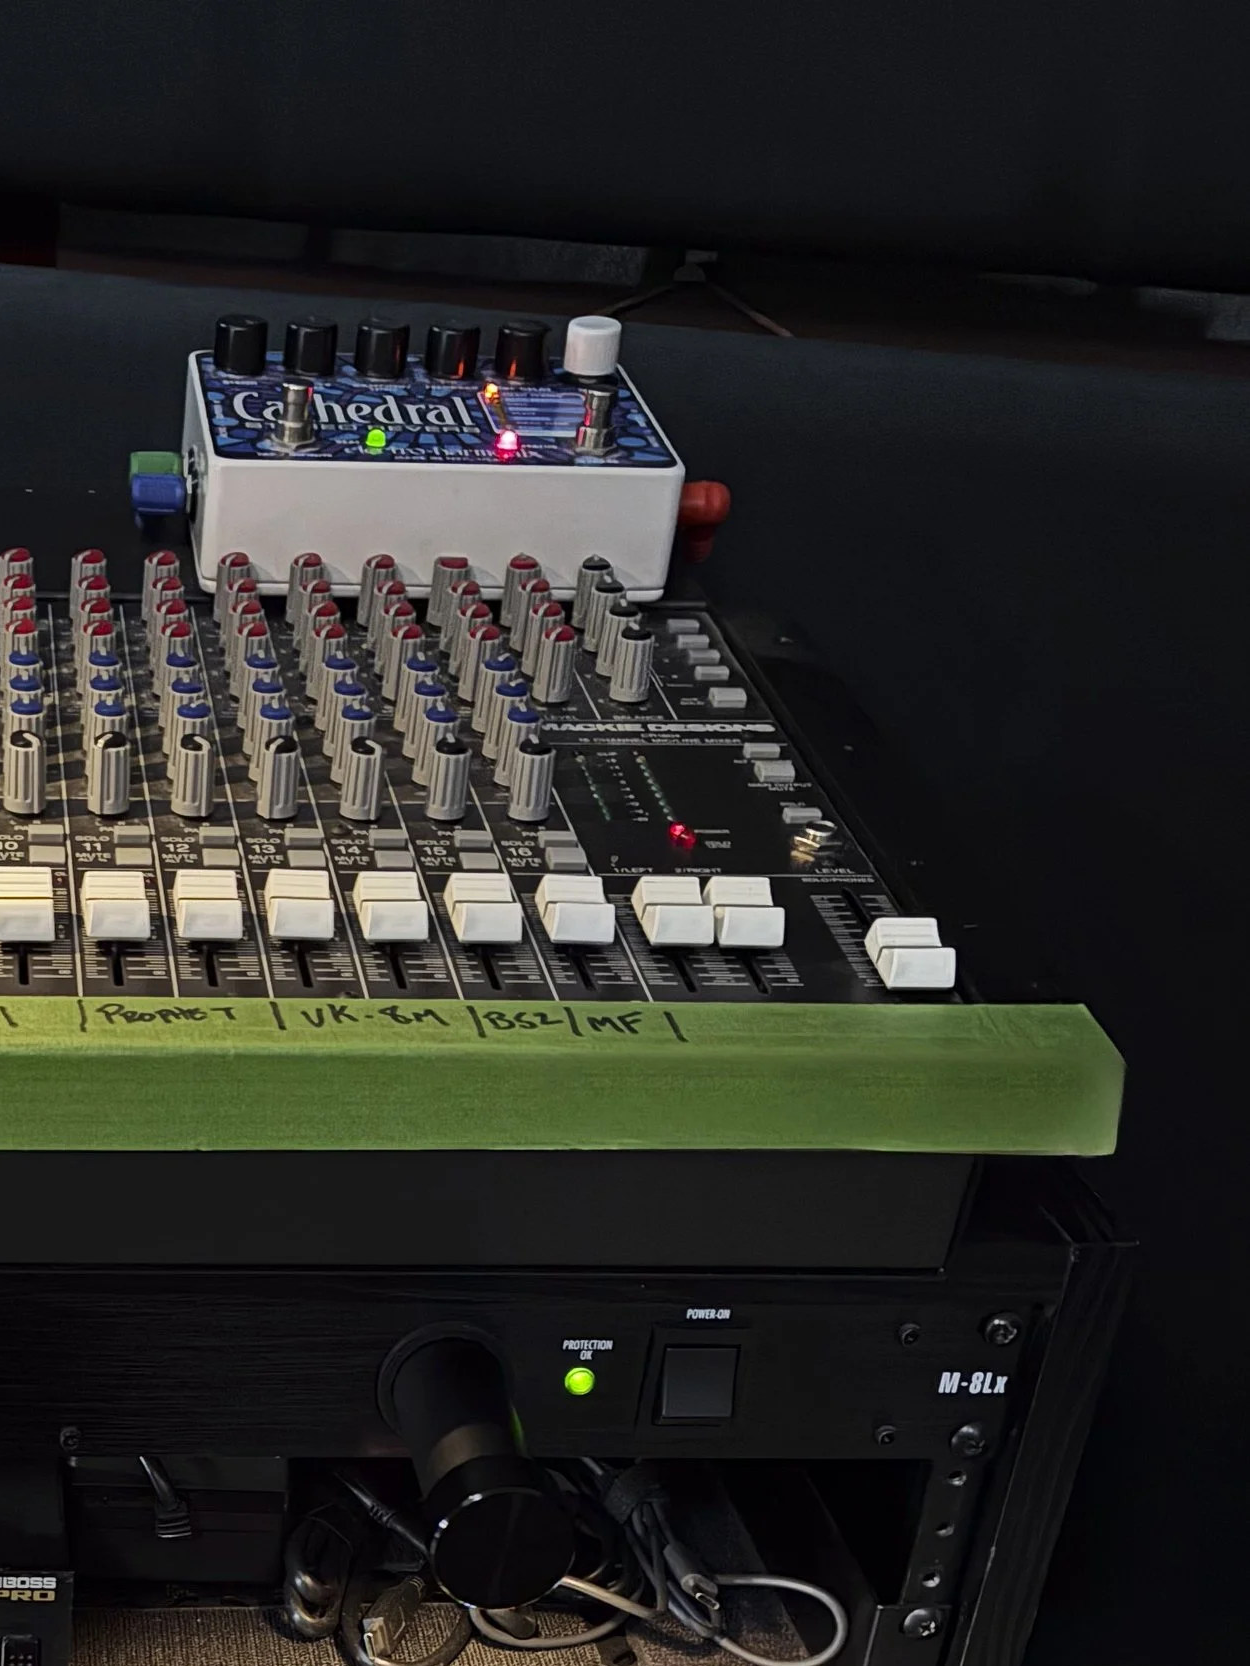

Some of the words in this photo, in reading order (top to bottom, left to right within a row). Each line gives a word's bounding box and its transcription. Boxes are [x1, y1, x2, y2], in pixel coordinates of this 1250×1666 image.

[233, 392, 473, 425] Cahedral
[647, 723, 776, 733] DESIGNS
[165, 844, 190, 853] 12
[588, 1011, 644, 1034] MF
[686, 1308, 731, 1320] POWER-ON
[563, 1339, 613, 1351] PROTECTION
[580, 1350, 593, 1361] OK
[938, 1372, 1008, 1395] M-8Lx
